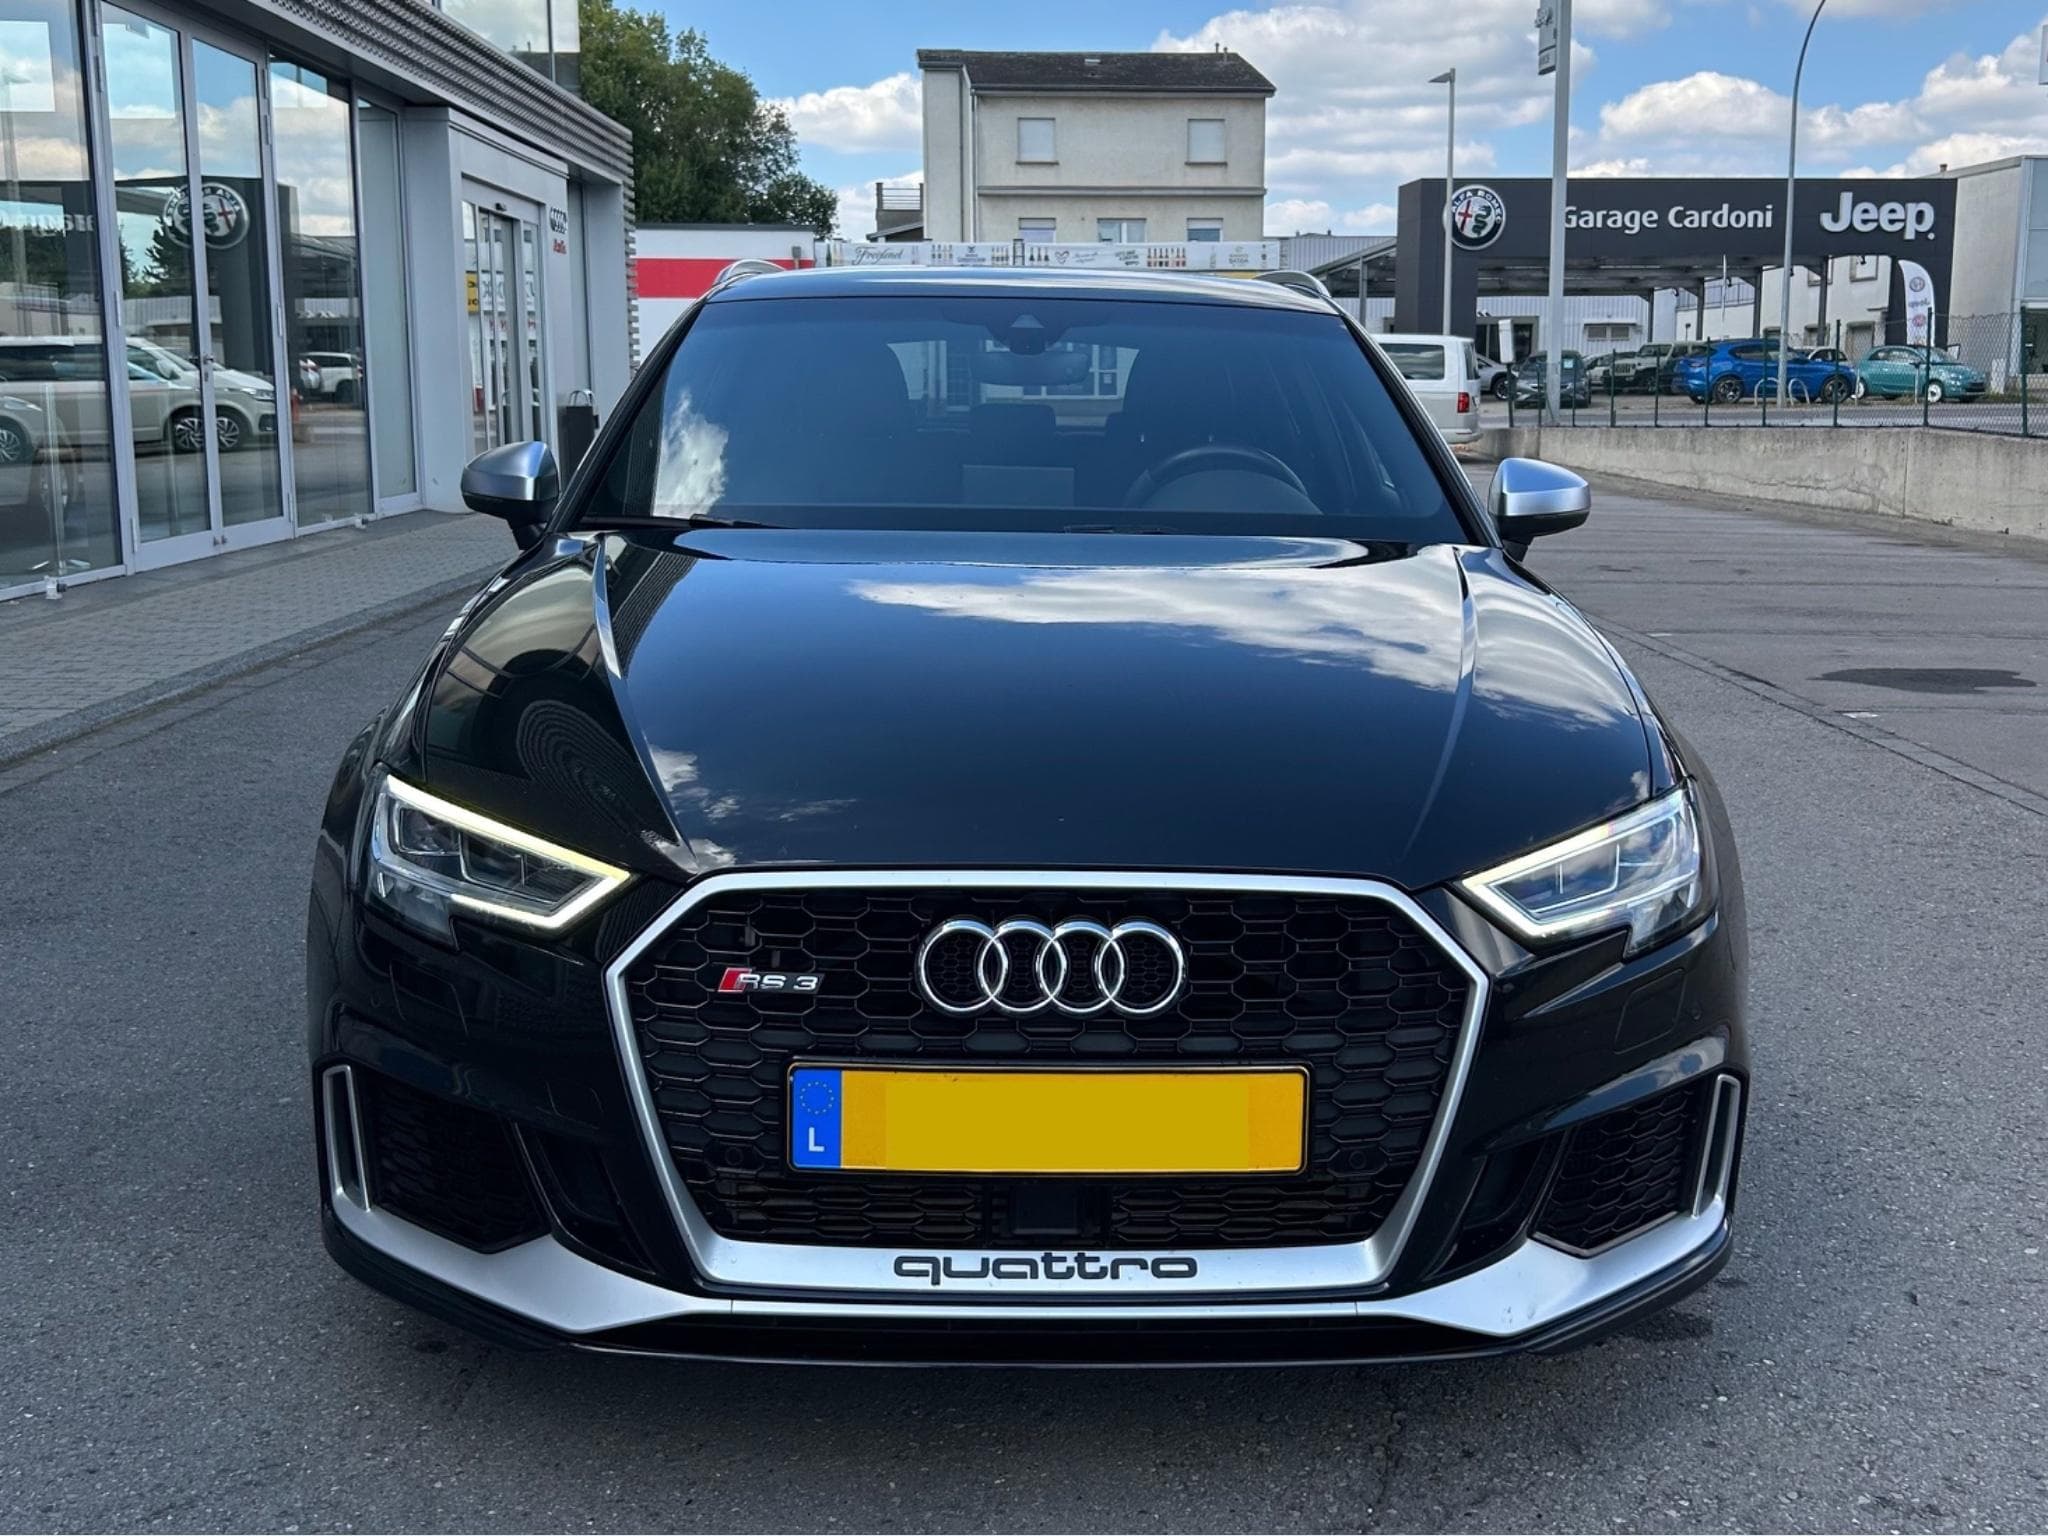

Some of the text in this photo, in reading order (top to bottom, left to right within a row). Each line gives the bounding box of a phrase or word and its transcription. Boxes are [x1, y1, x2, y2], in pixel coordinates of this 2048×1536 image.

[1477, 189, 1502, 224] ROMEO
[1564, 203, 1773, 234] Garage Cardoni
[1820, 191, 1935, 240] Jeep
[808, 1126, 825, 1152] L
[893, 1252, 1199, 1286] quattro
